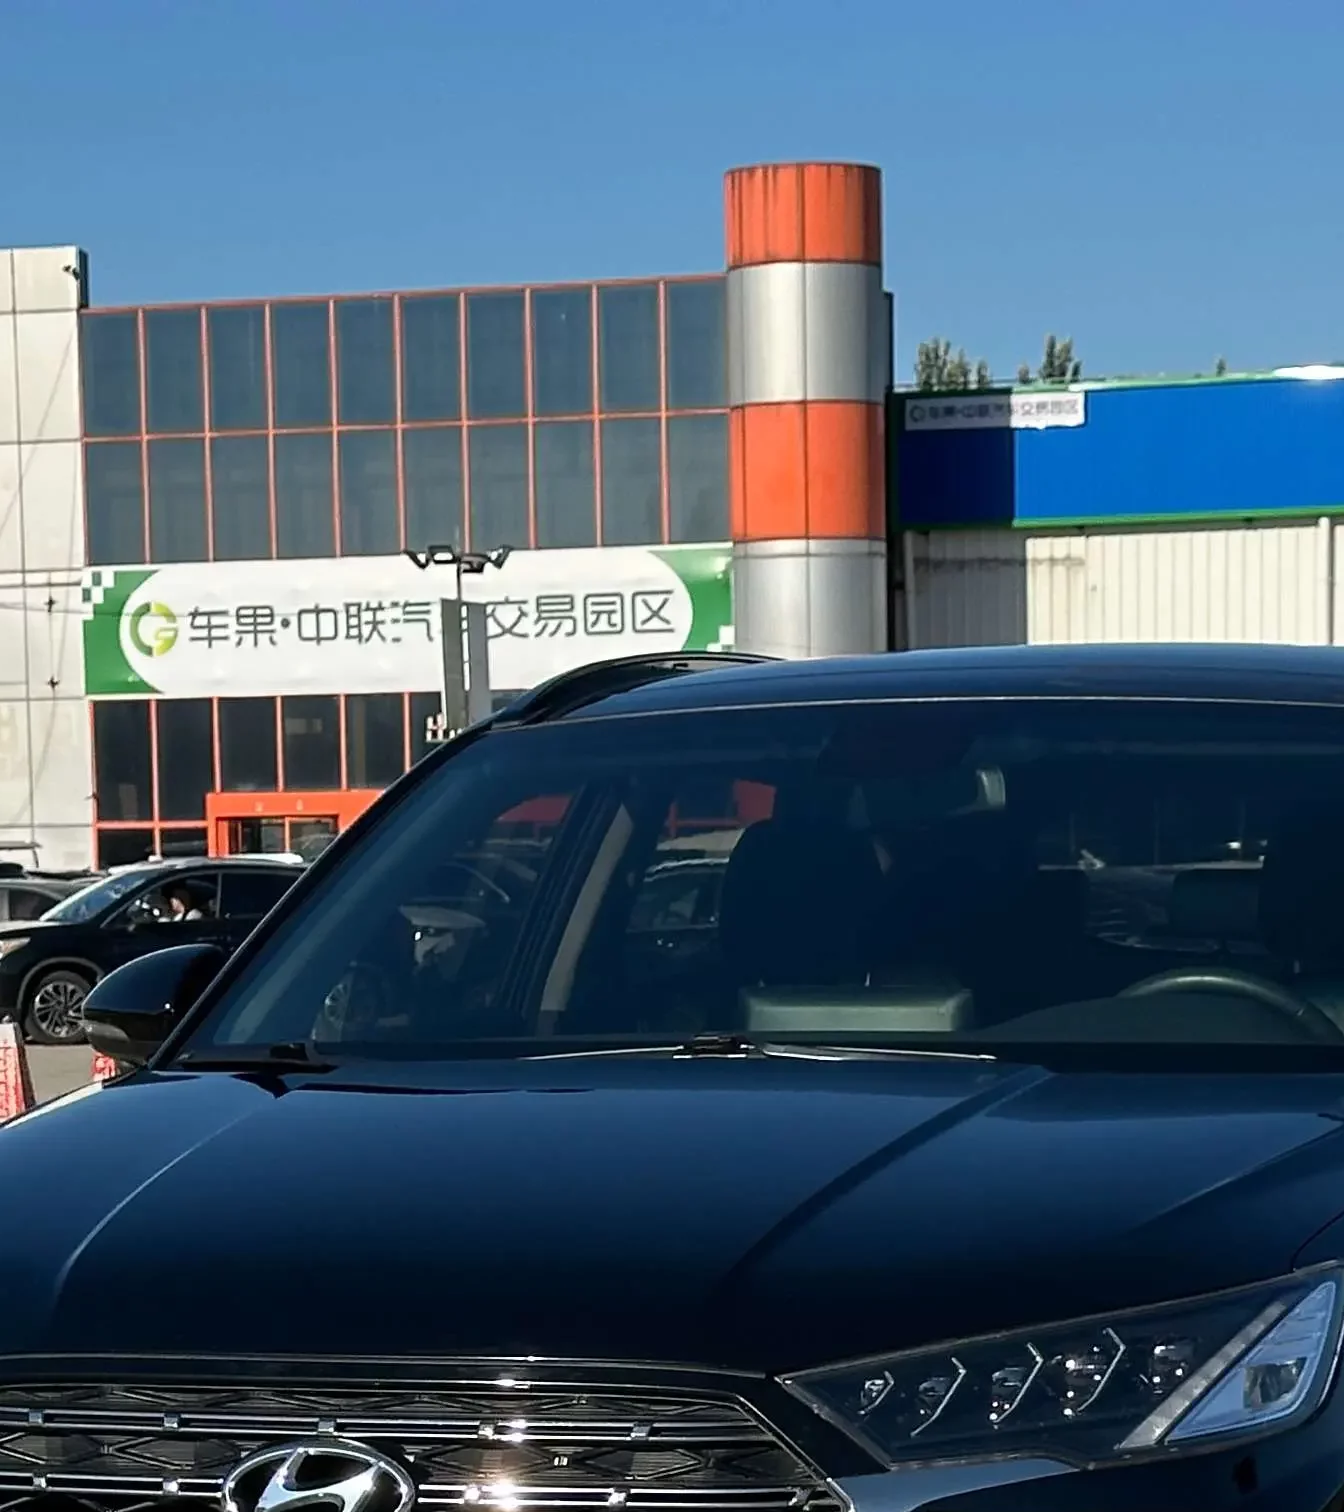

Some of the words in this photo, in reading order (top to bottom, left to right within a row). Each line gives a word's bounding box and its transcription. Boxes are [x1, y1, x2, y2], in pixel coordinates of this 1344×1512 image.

[188, 590, 675, 649] 车果·中联汽交易园区
